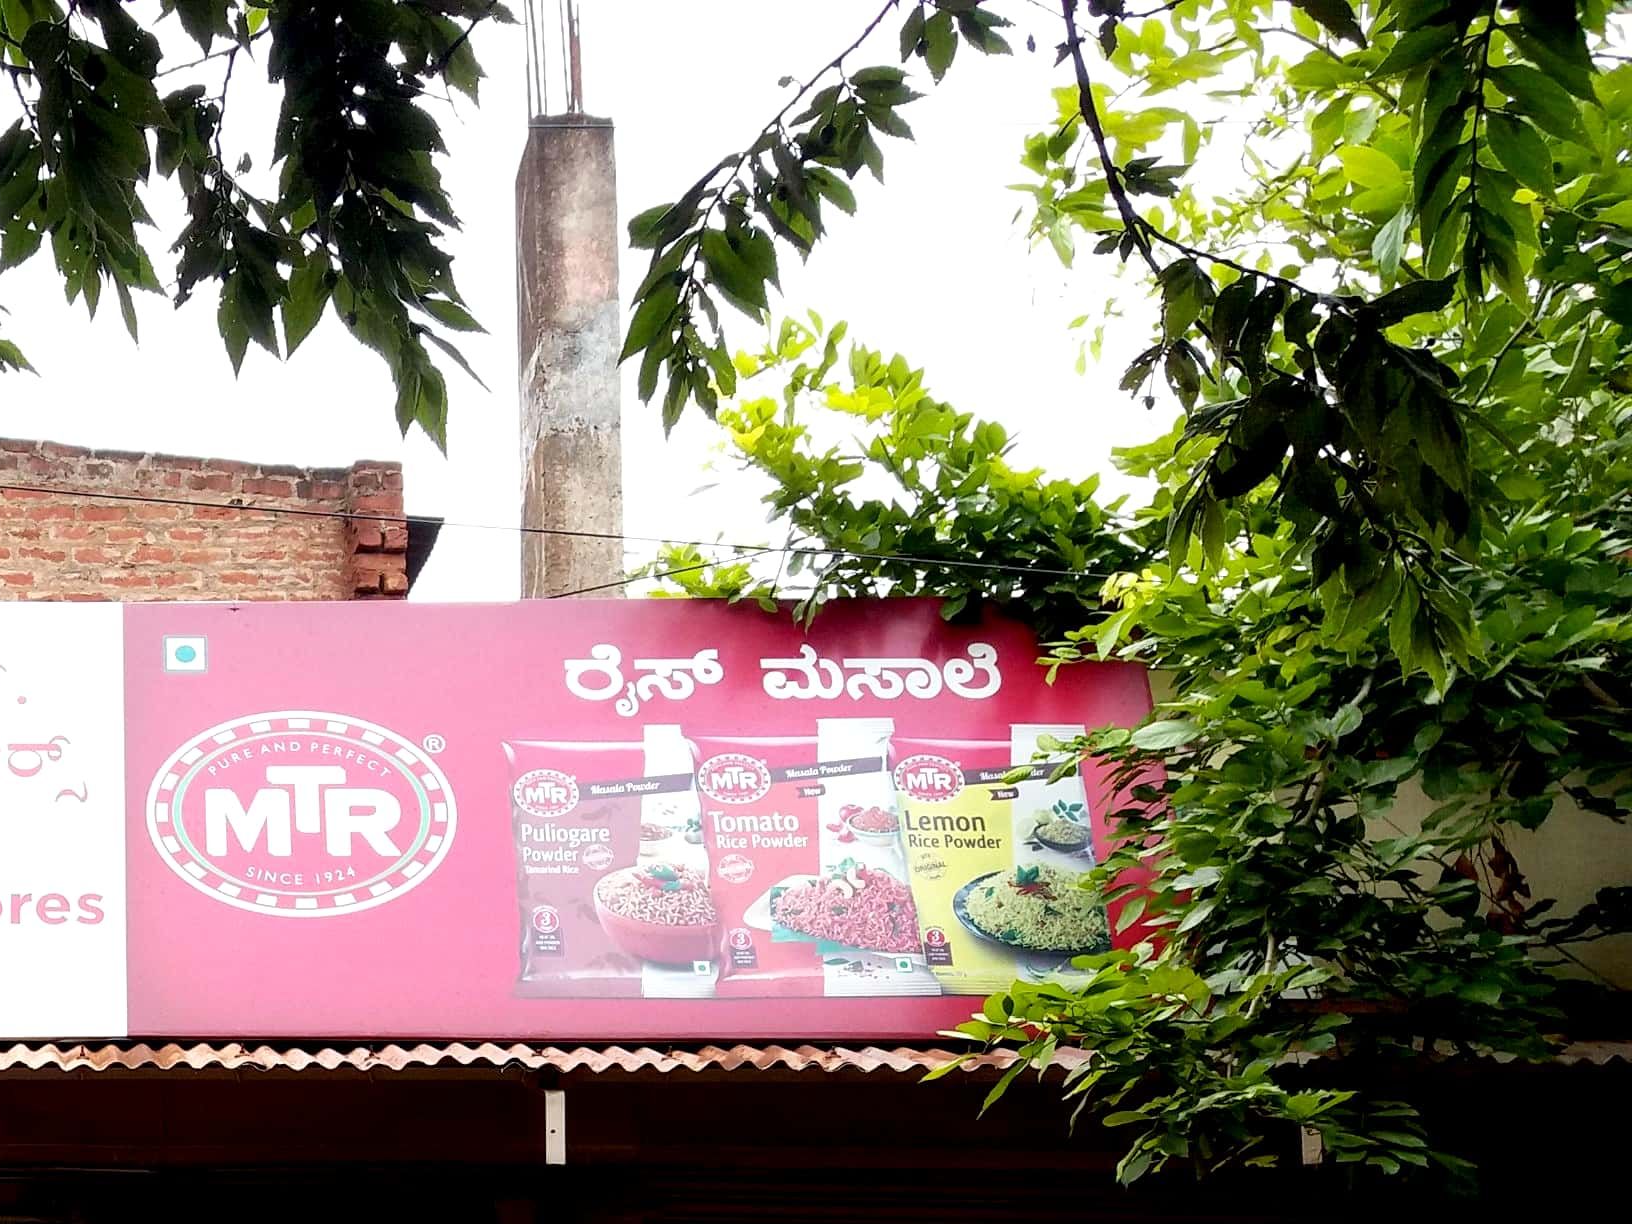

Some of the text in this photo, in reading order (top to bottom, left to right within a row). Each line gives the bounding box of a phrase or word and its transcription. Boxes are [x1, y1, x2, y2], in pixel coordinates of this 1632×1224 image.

[563, 643, 724, 717] ರೈಸ್
[207, 740, 392, 778] PURE AND PERFECT
[712, 766, 758, 790] MTR
[906, 767, 952, 791] MTR
[525, 781, 567, 804] MTR
[204, 764, 402, 857] MTR
[707, 811, 799, 833] Tomato
[905, 810, 986, 832] Lemon
[521, 823, 610, 848] Puliogare
[716, 833, 808, 849] Rice Powder
[909, 833, 1002, 849] Rice Powder
[522, 847, 578, 863] Powder
[246, 866, 356, 886] SINCE 1924
